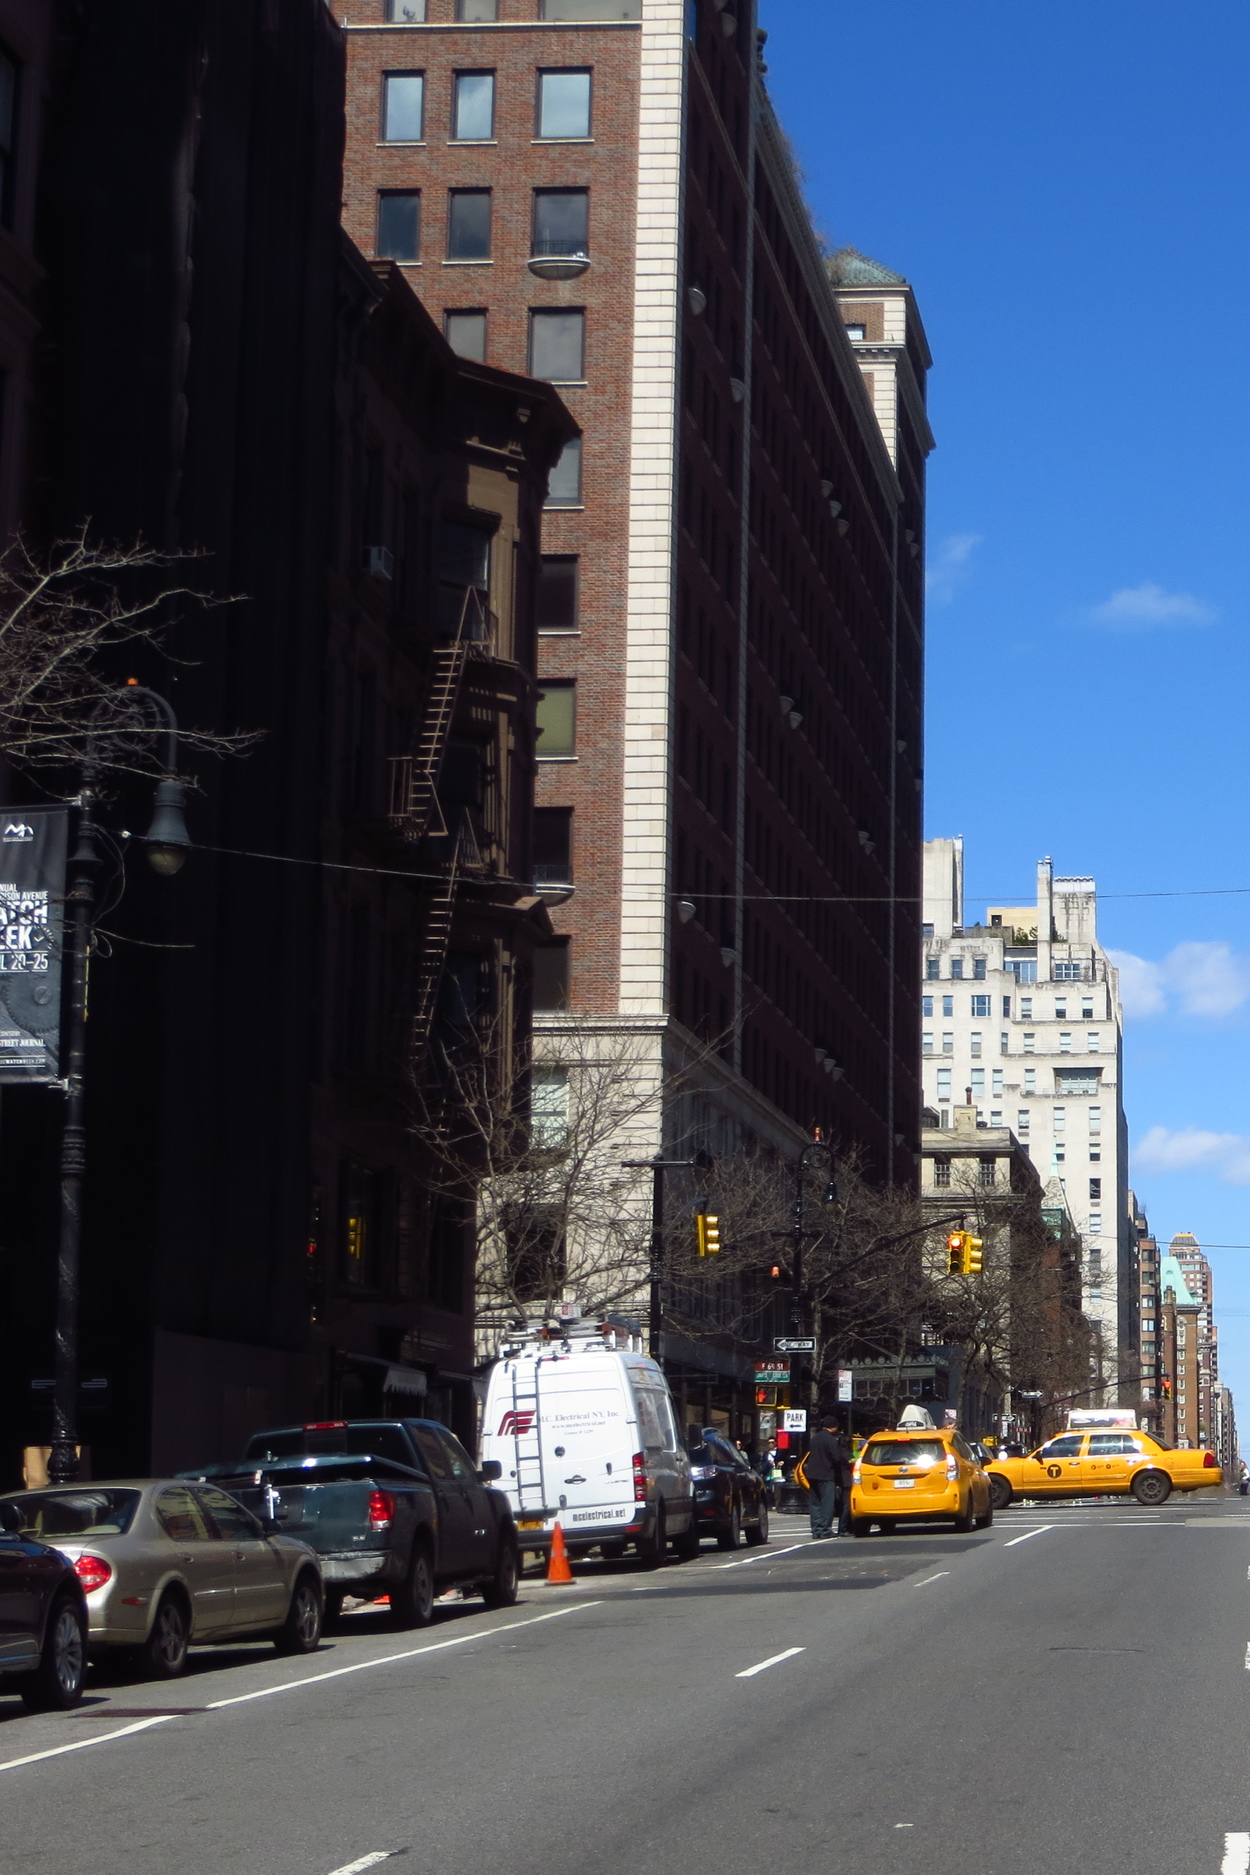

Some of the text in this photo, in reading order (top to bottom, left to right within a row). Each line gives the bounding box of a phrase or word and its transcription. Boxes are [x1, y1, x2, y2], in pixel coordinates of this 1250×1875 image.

[21, 891, 48, 900] AVENUE
[555, 1411, 590, 1422] Electrical
[787, 1413, 804, 1422] PARK
[572, 1508, 626, 1522] mcelectrical.net
